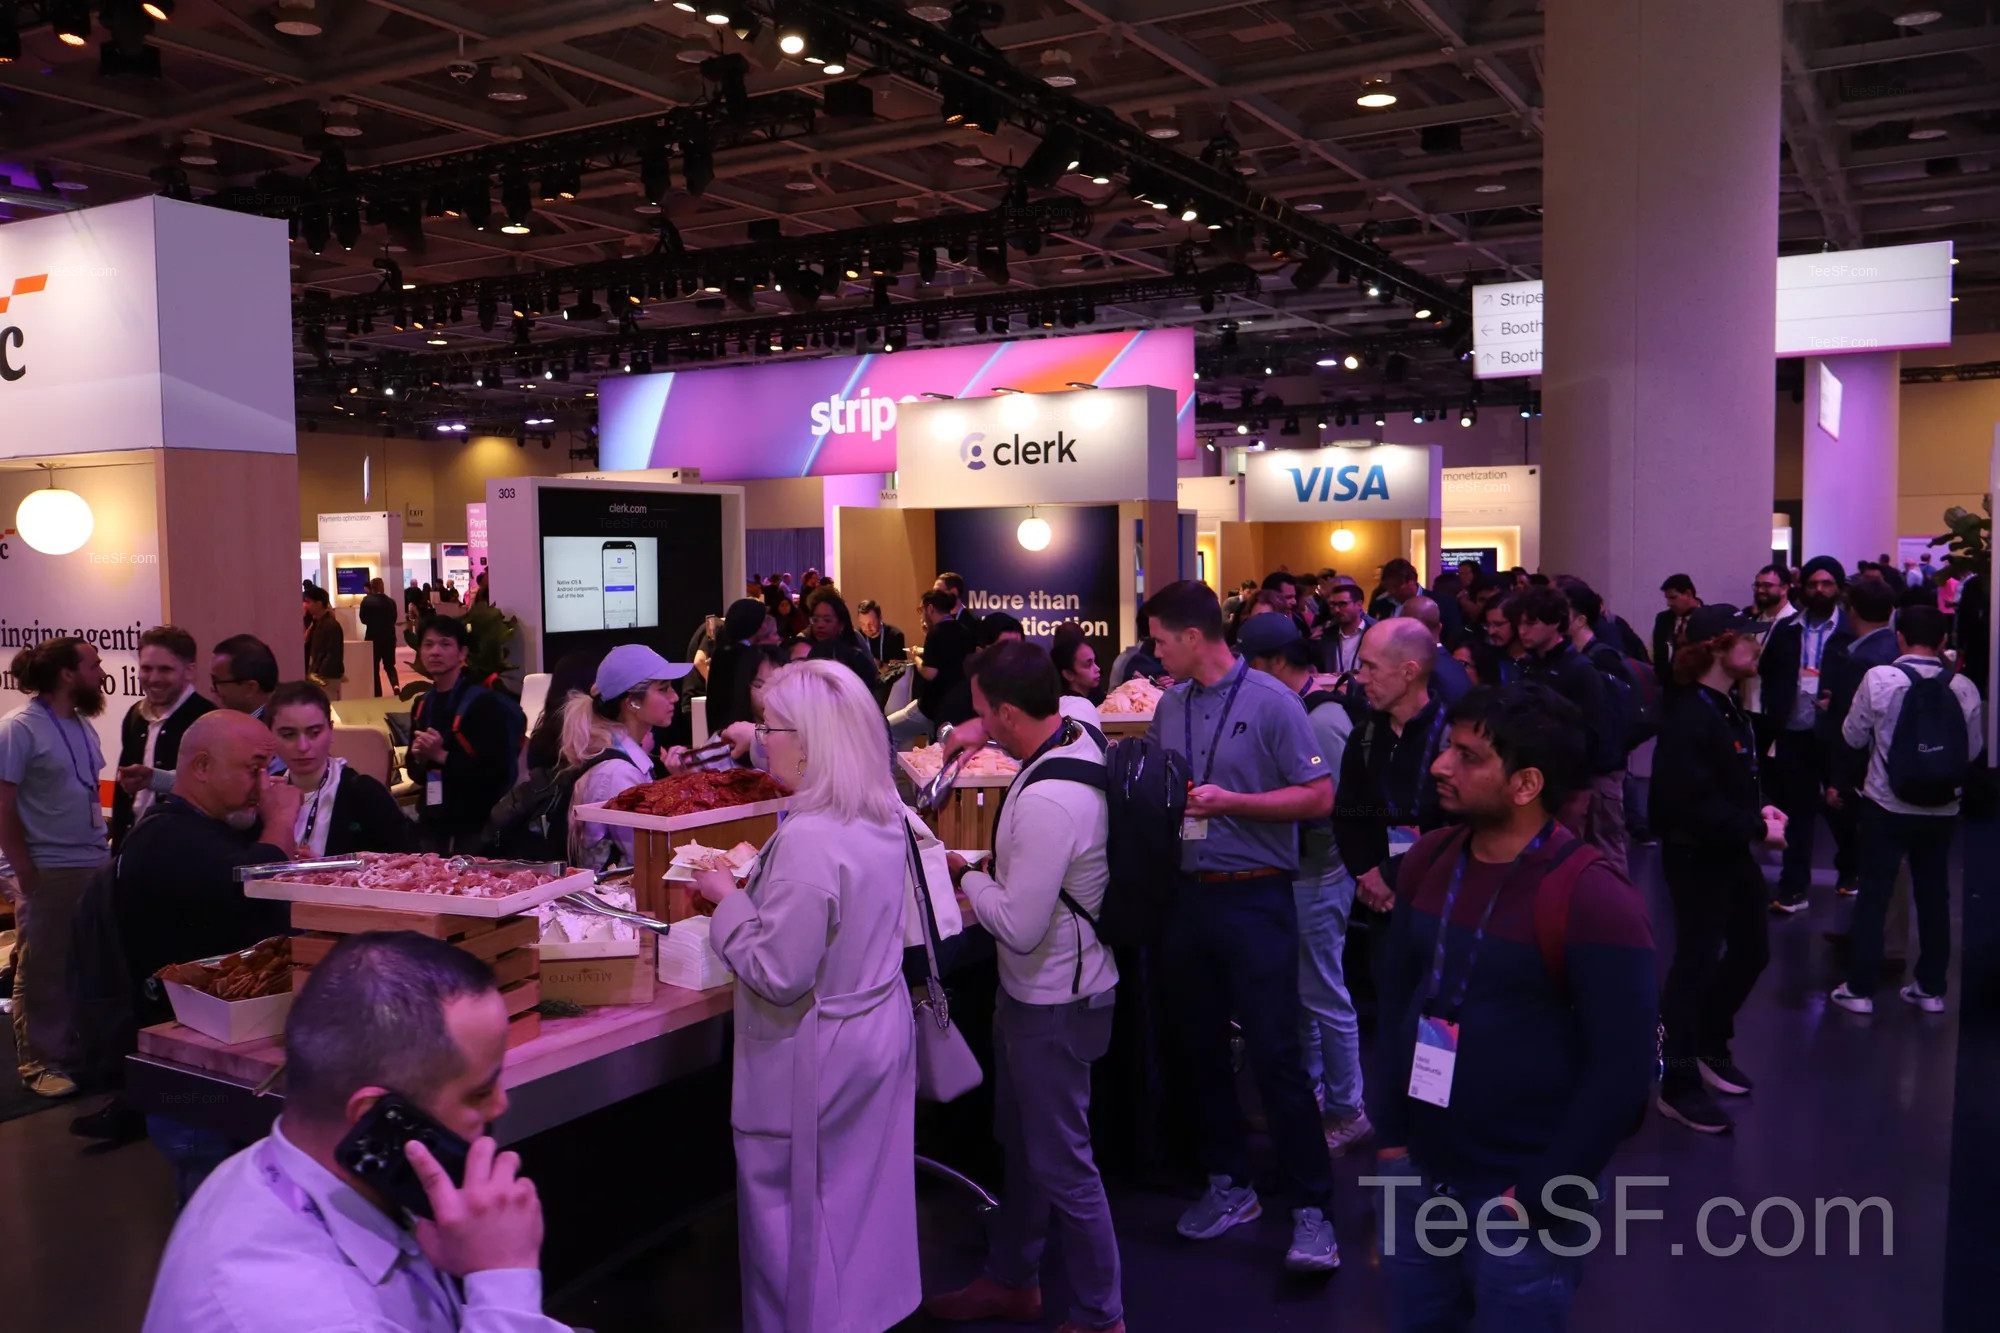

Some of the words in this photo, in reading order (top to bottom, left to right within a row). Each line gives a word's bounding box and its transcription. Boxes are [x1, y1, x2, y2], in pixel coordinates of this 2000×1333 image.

[1500, 292, 1543, 306] Stripe
[1501, 320, 1543, 335] Booth
[1501, 349, 1543, 364] Booth
[810, 387, 918, 441] strip
[992, 430, 1078, 467] clerk
[1284, 464, 1390, 502] VISA
[1443, 471, 1508, 480] monetization
[498, 488, 516, 499] 303
[609, 503, 647, 514] clerk.com
[319, 515, 341, 523] Payments
[342, 514, 371, 522] optimization
[968, 590, 1024, 610] More
[1029, 590, 1080, 610] than
